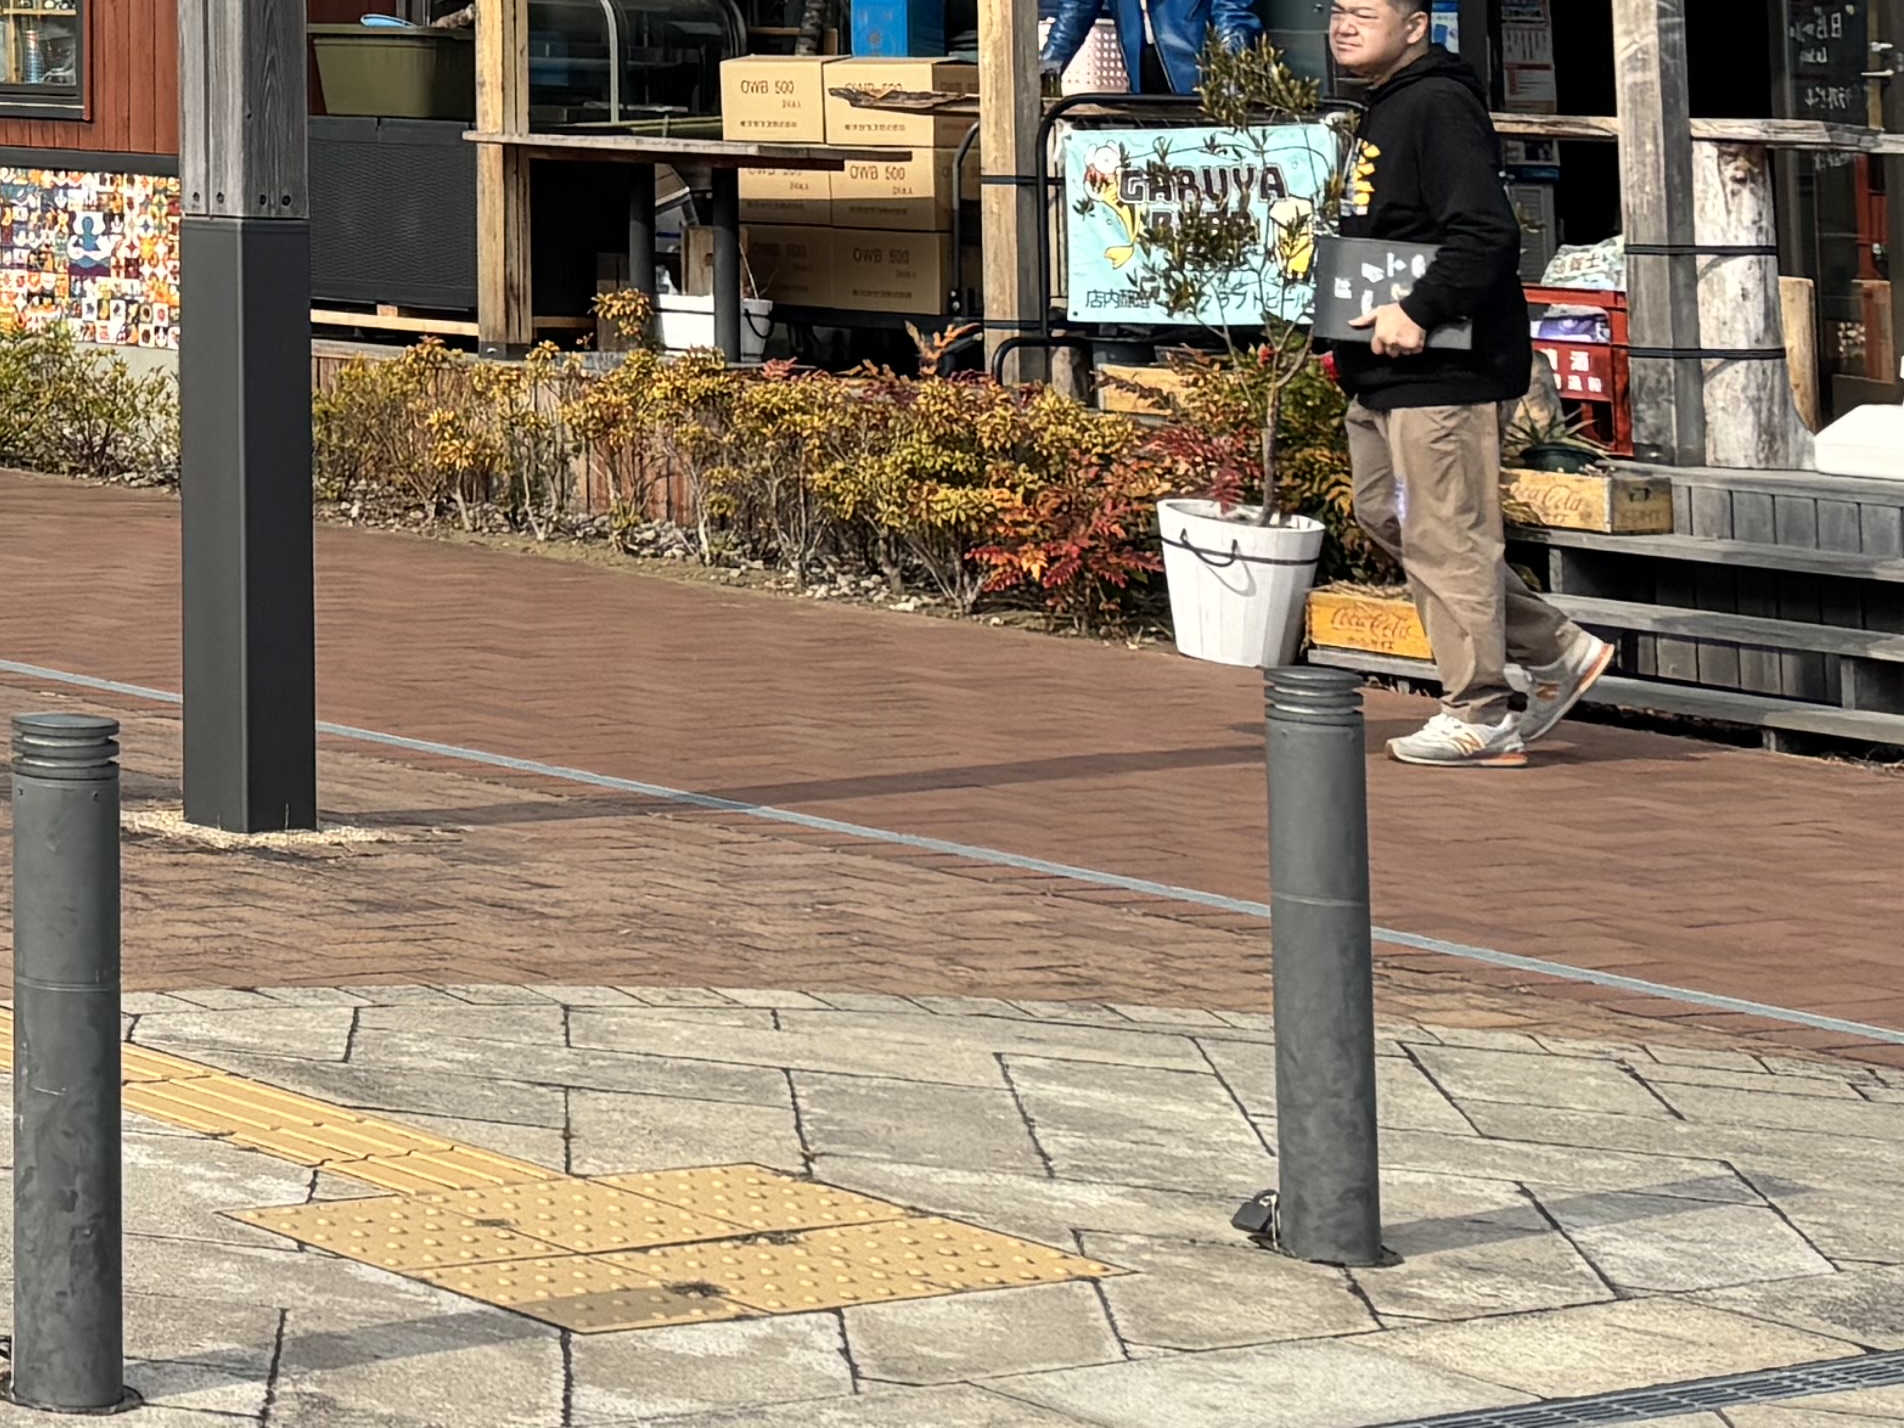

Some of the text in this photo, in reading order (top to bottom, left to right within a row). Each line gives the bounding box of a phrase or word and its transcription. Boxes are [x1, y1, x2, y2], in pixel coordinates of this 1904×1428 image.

[740, 79, 795, 95] OWB 500
[849, 164, 906, 181] OWB 500
